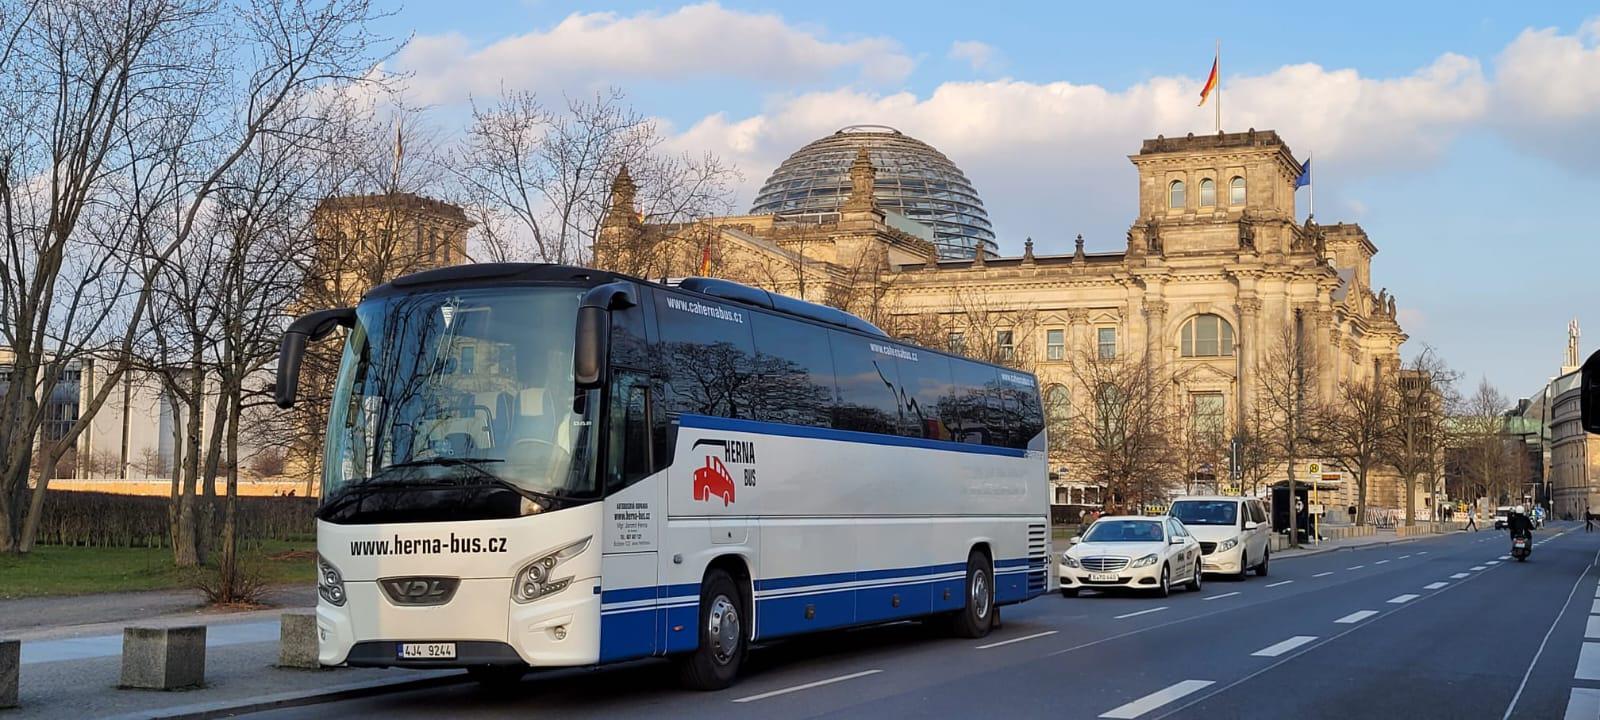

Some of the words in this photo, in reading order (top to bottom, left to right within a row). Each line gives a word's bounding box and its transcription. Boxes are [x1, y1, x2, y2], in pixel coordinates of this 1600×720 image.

[666, 297, 743, 323] www.cahernabus.cz
[724, 440, 755, 464] HERNA
[744, 468, 756, 487] BUS
[350, 533, 507, 556] www.herna-bus.cz
[392, 580, 445, 598] VDL
[405, 645, 422, 657] 4J4
[428, 645, 452, 657] 9244
